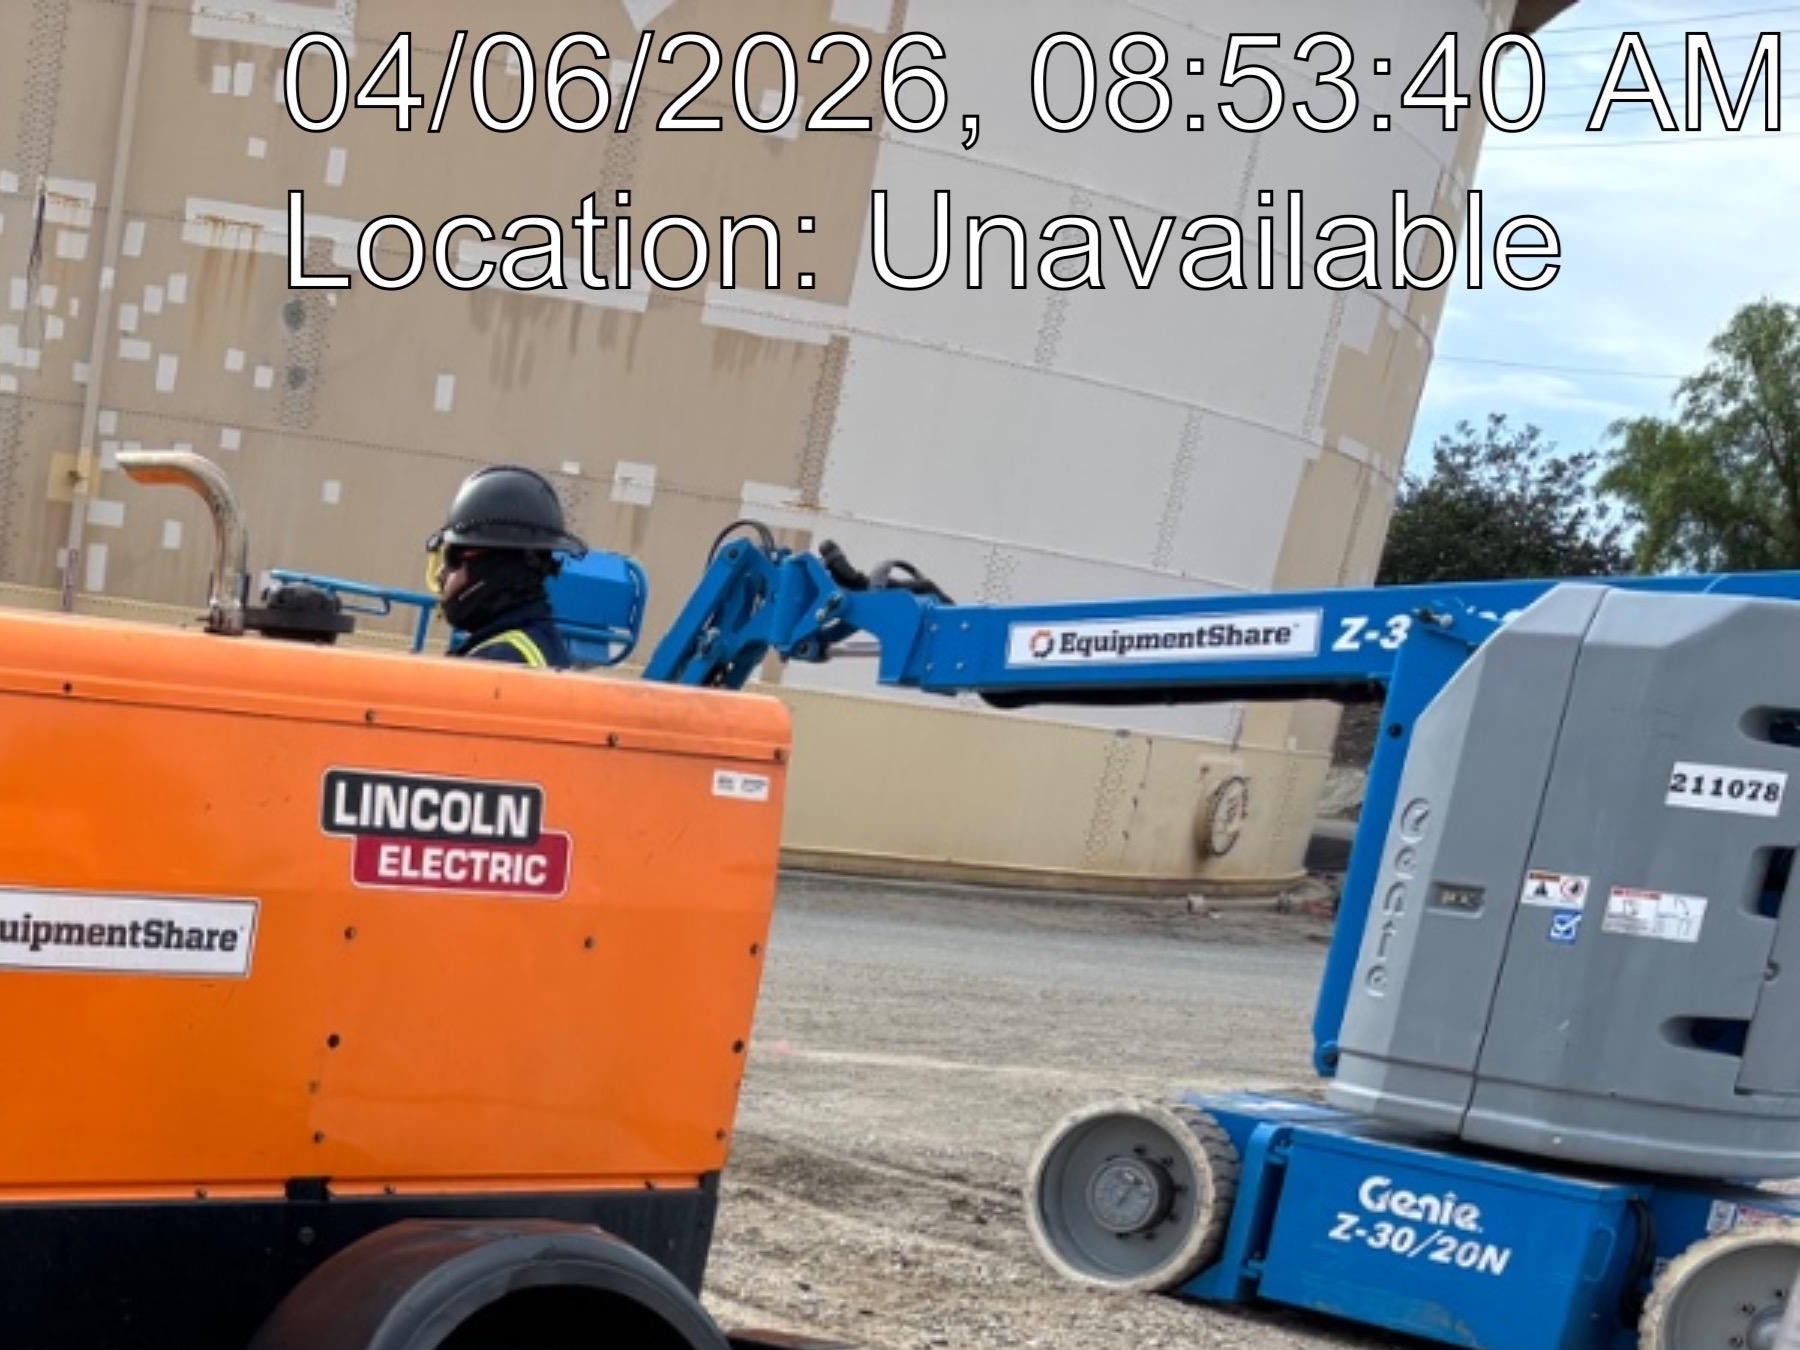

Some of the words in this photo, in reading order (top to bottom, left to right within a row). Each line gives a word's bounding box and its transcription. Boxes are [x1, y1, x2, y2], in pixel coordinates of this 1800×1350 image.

[1059, 624, 1294, 655] EquipmentShare
[332, 781, 531, 839] LINCOLN
[1669, 773, 1780, 802] 211078
[377, 844, 548, 887] ELECTRIC
[1358, 1175, 1481, 1233] Genie
[1327, 1211, 1512, 1277] Z-30/20N
